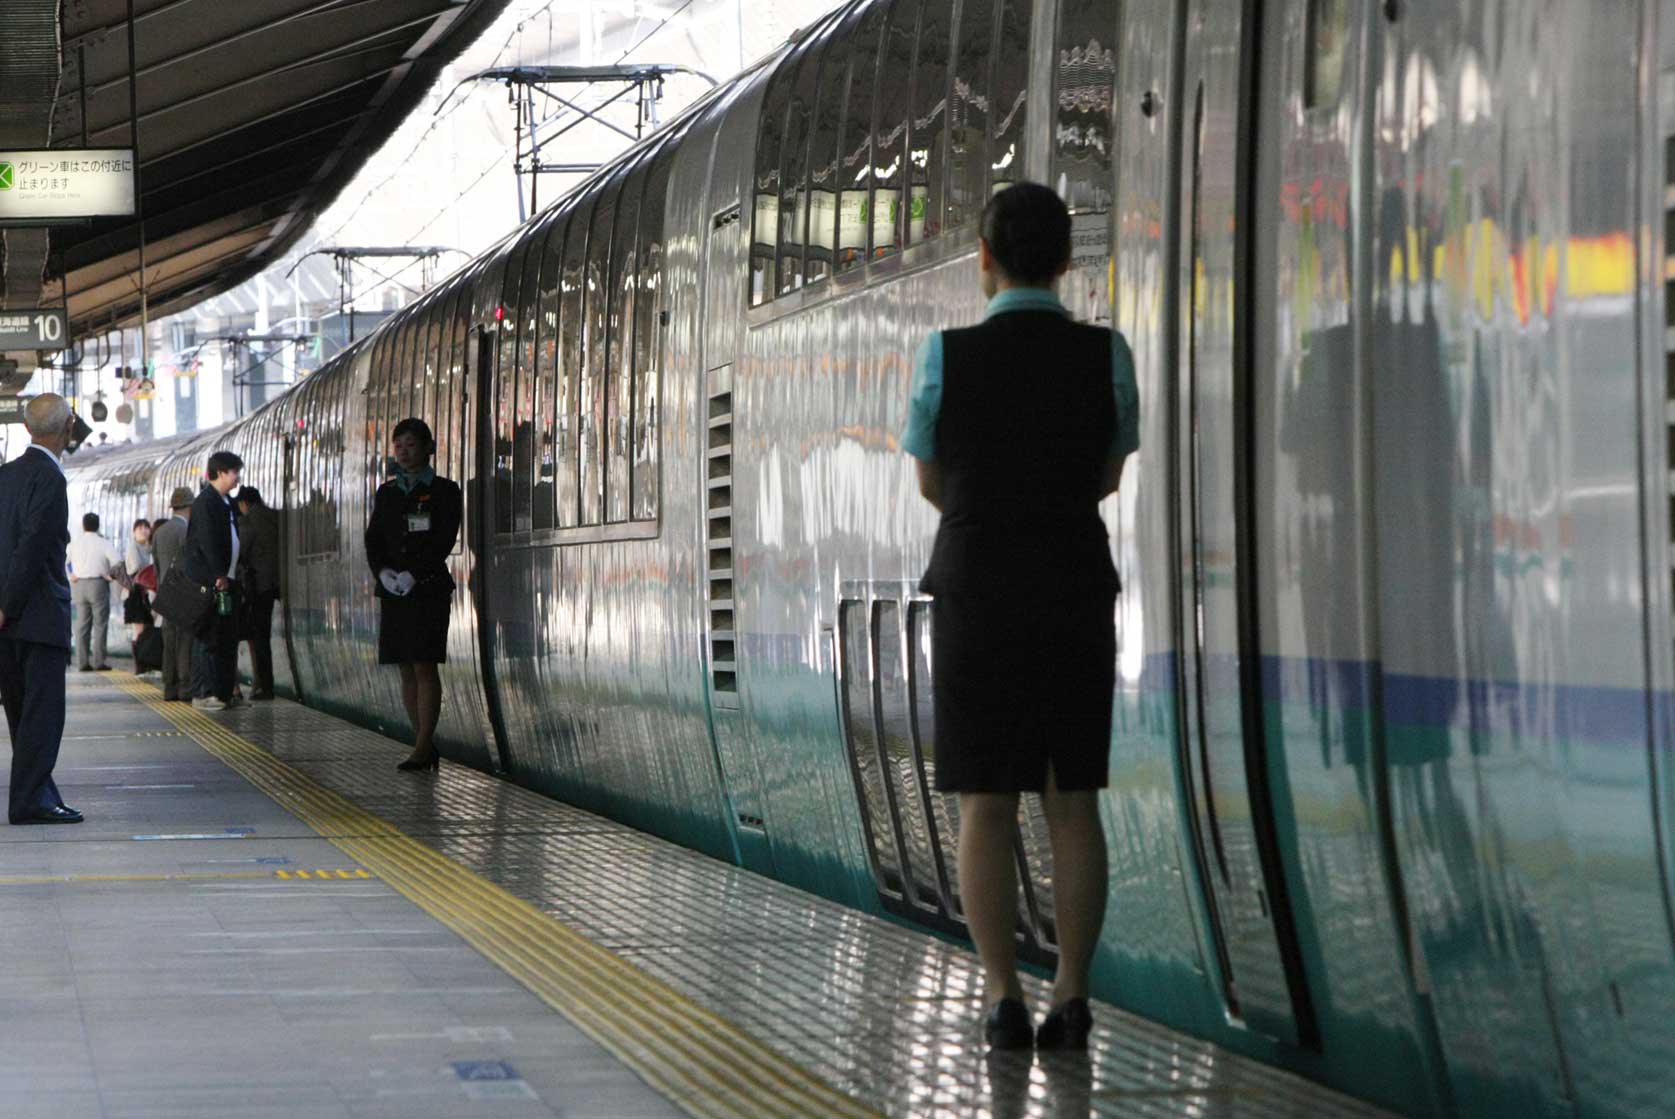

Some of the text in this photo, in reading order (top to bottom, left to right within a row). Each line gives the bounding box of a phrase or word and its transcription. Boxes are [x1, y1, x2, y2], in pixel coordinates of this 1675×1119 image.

[18, 160, 132, 174] グリーン車はこの付近に
[18, 177, 70, 190] 止まります
[34, 314, 61, 342] 10
